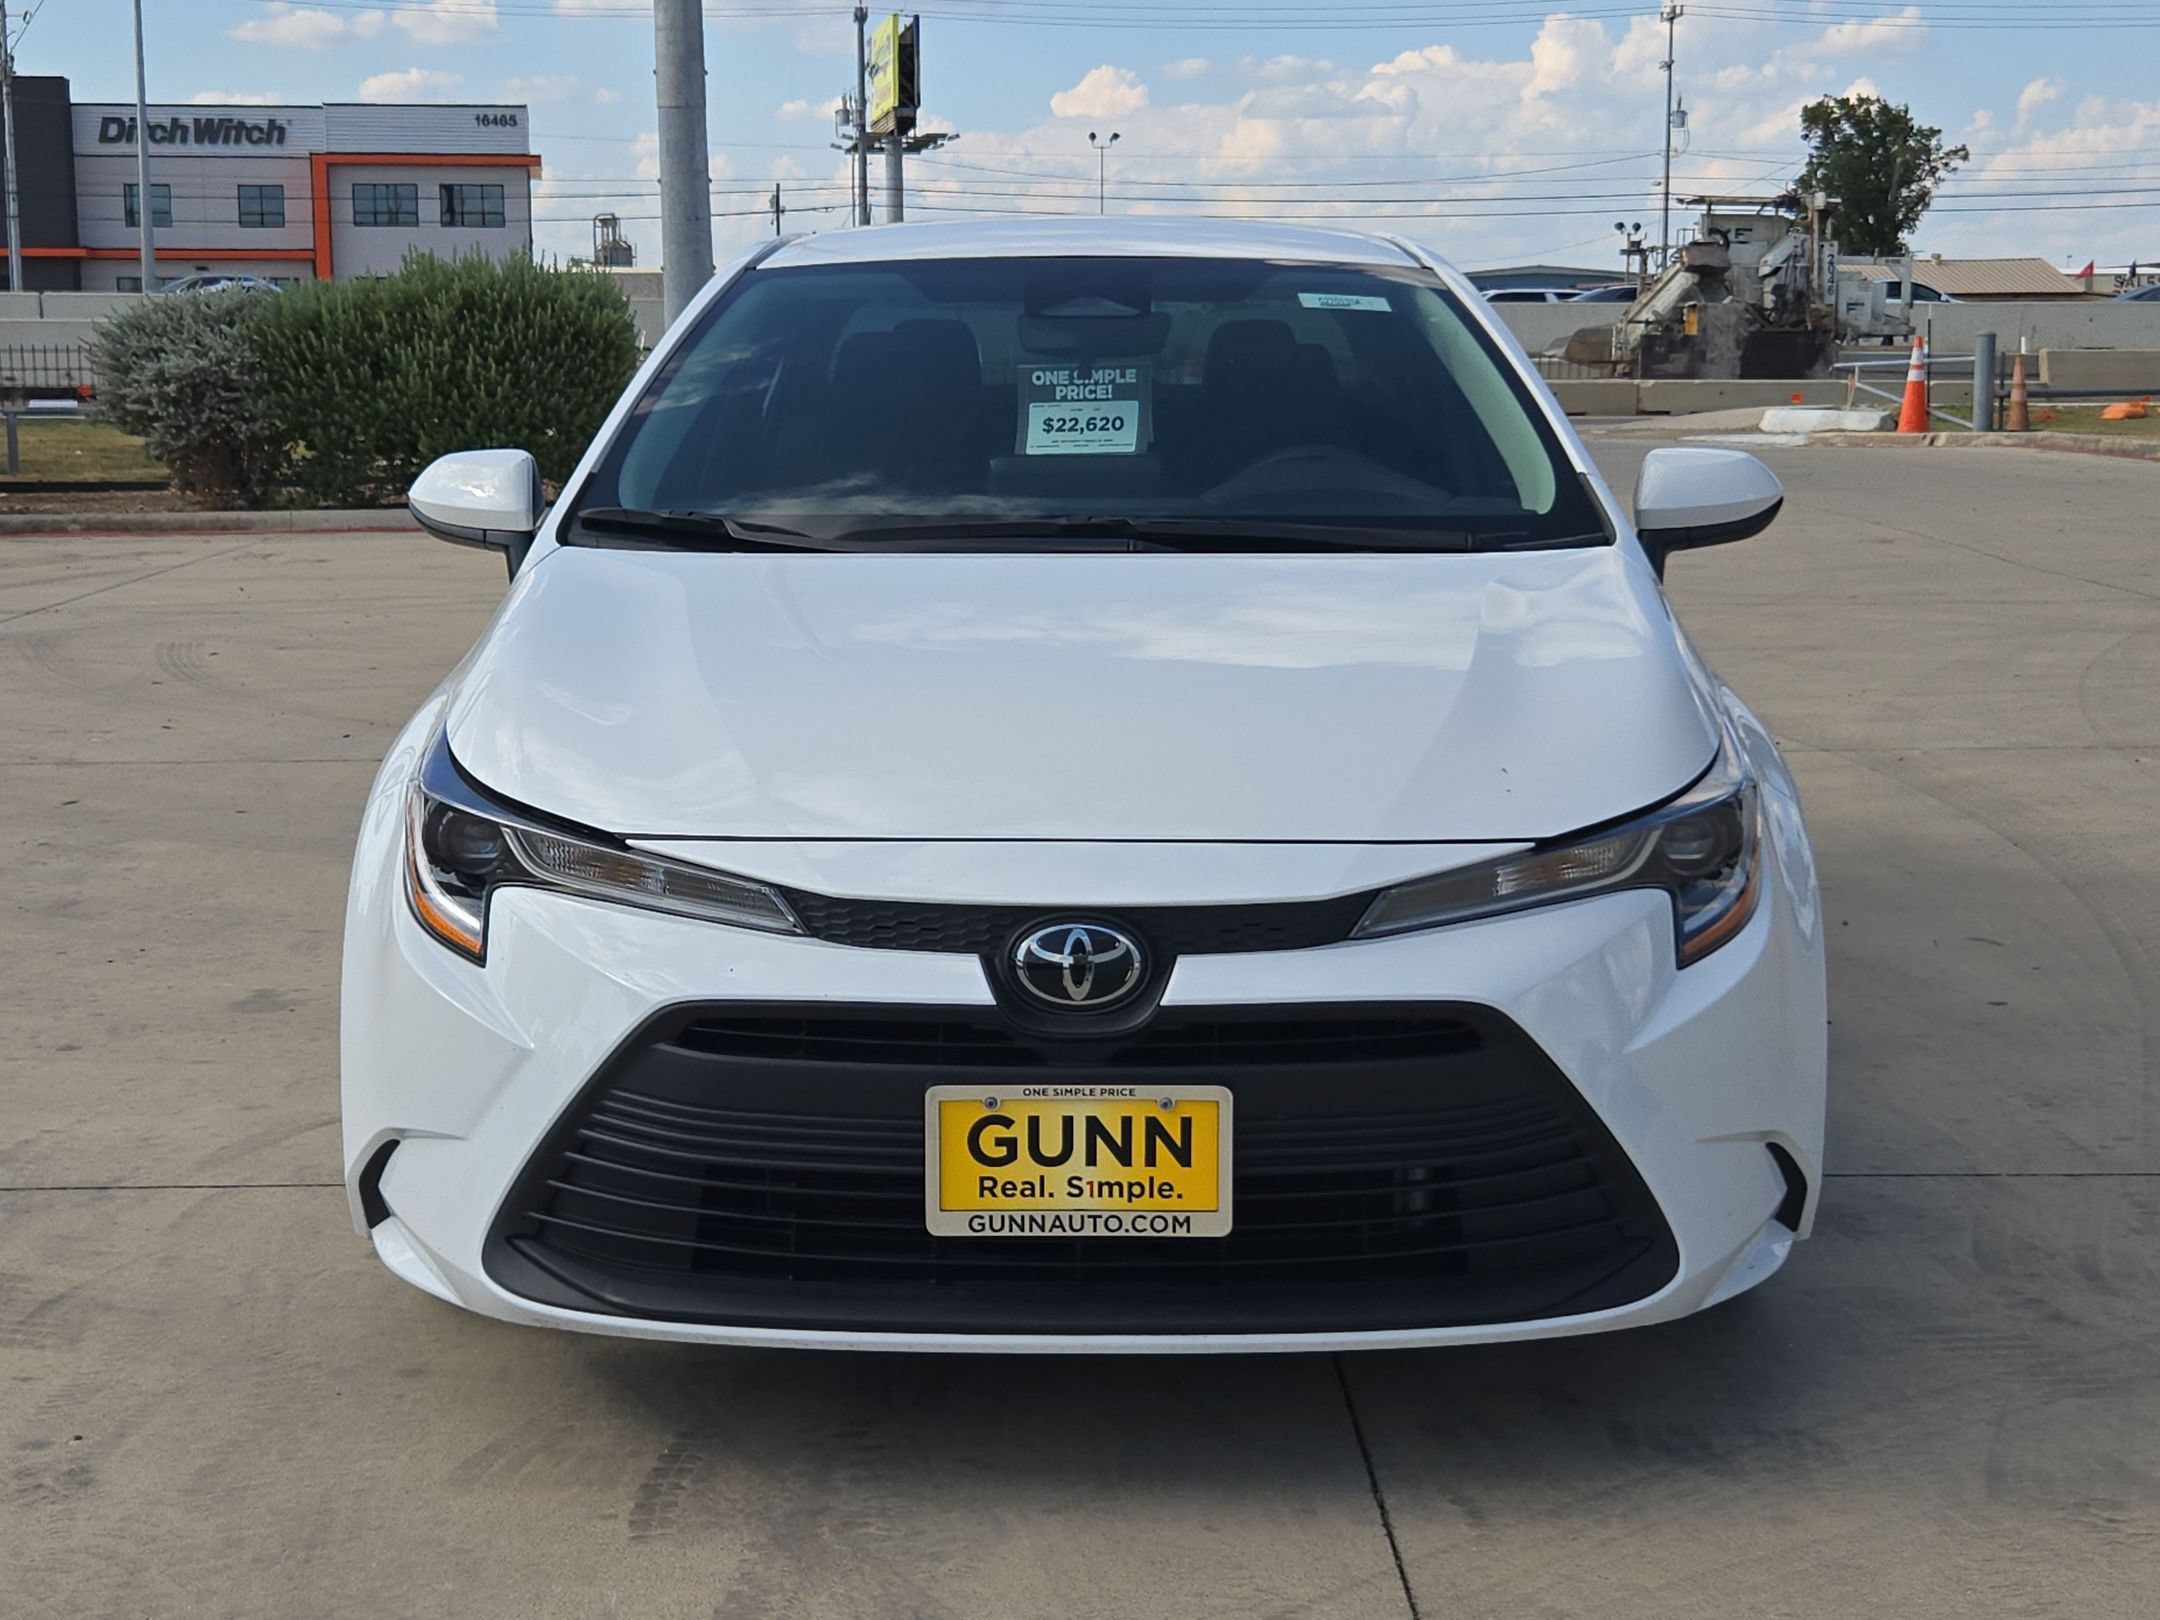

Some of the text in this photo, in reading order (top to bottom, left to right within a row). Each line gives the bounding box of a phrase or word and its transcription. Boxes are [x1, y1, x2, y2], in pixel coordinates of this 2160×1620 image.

[98, 116, 287, 145] Dich Witch
[2112, 274, 2160, 288] SALE
[1031, 368, 1137, 386] ONE SMPLE
[1055, 384, 1113, 400] PRICE!
[1042, 415, 1125, 435] $22,620
[1022, 1087, 1136, 1097] ONE SIMPLE PRICE
[966, 1114, 1192, 1168] GUNN
[978, 1174, 1054, 1199] Real.
[967, 1214, 1191, 1233] GUNNAUTO.COM
